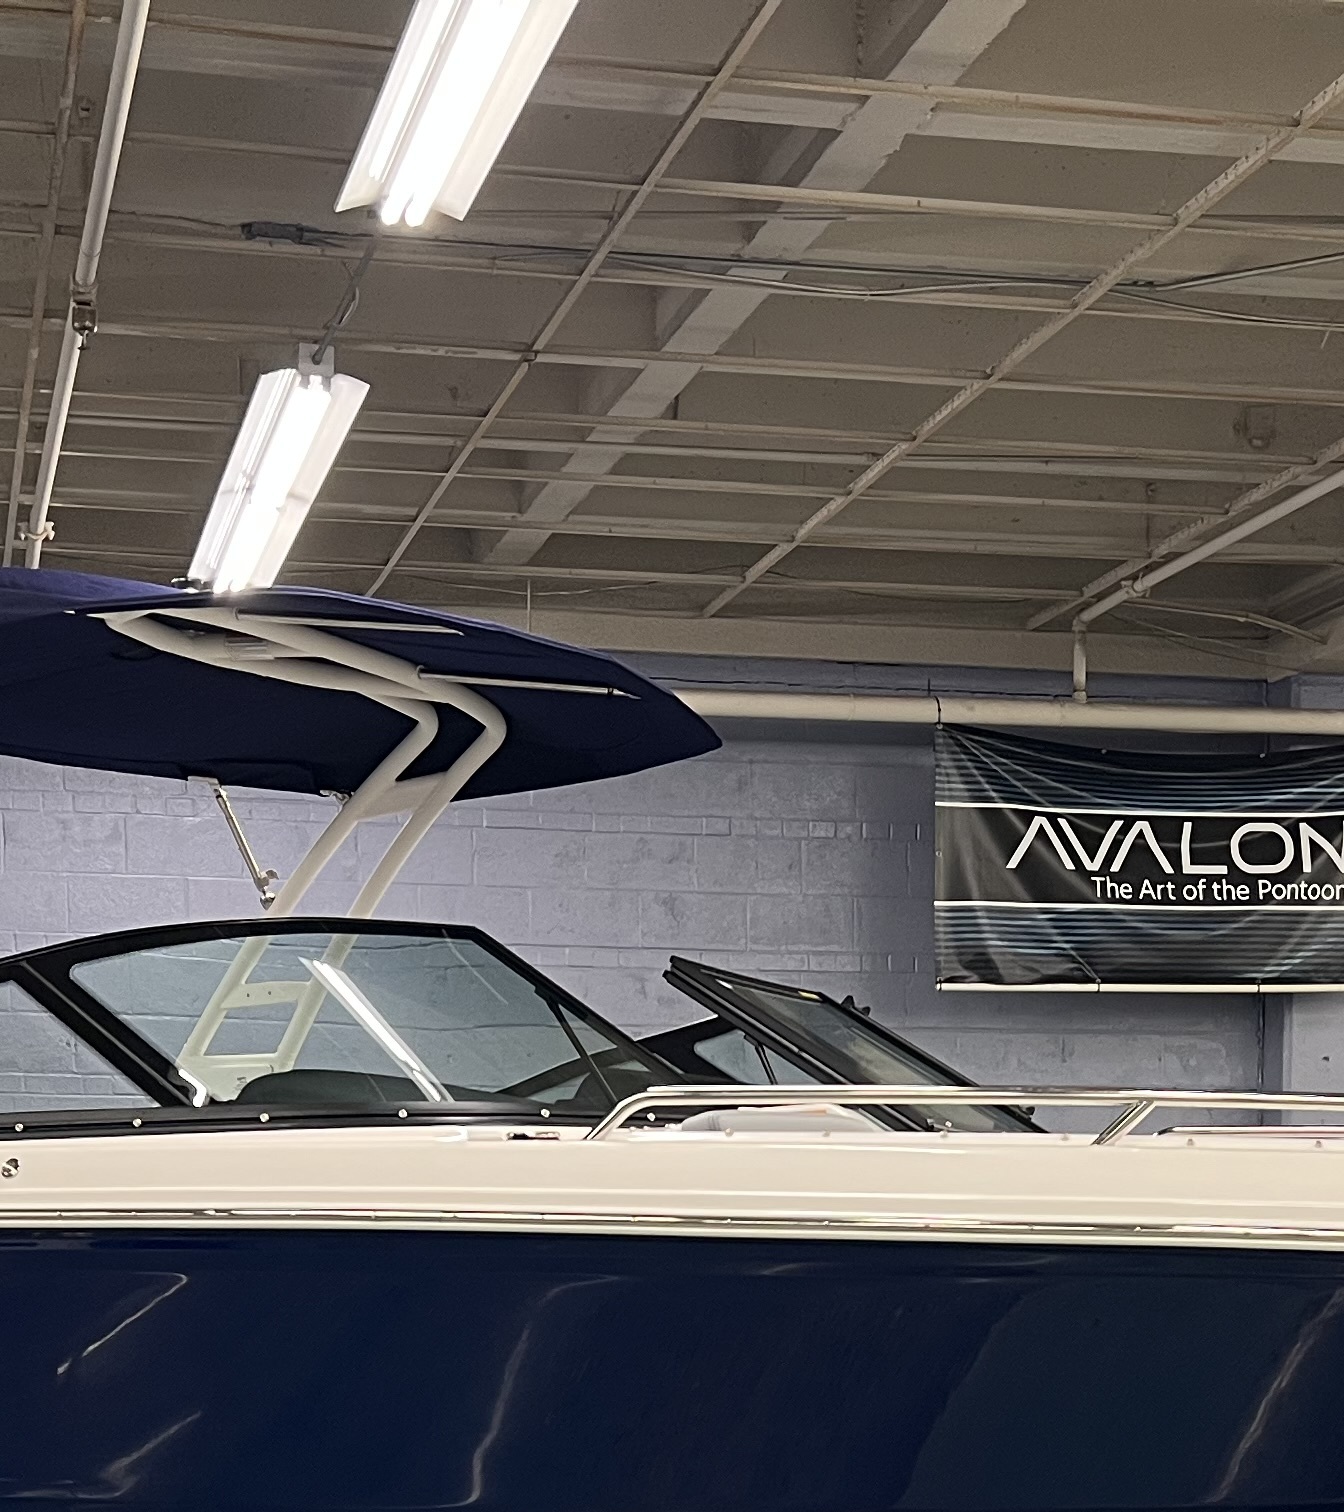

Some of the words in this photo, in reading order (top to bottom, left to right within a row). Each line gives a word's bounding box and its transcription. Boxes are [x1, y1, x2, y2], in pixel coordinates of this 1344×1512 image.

[1090, 876, 1133, 899] The
[1139, 879, 1177, 900] Art
[1182, 879, 1206, 901] of
[1212, 880, 1250, 901] the
